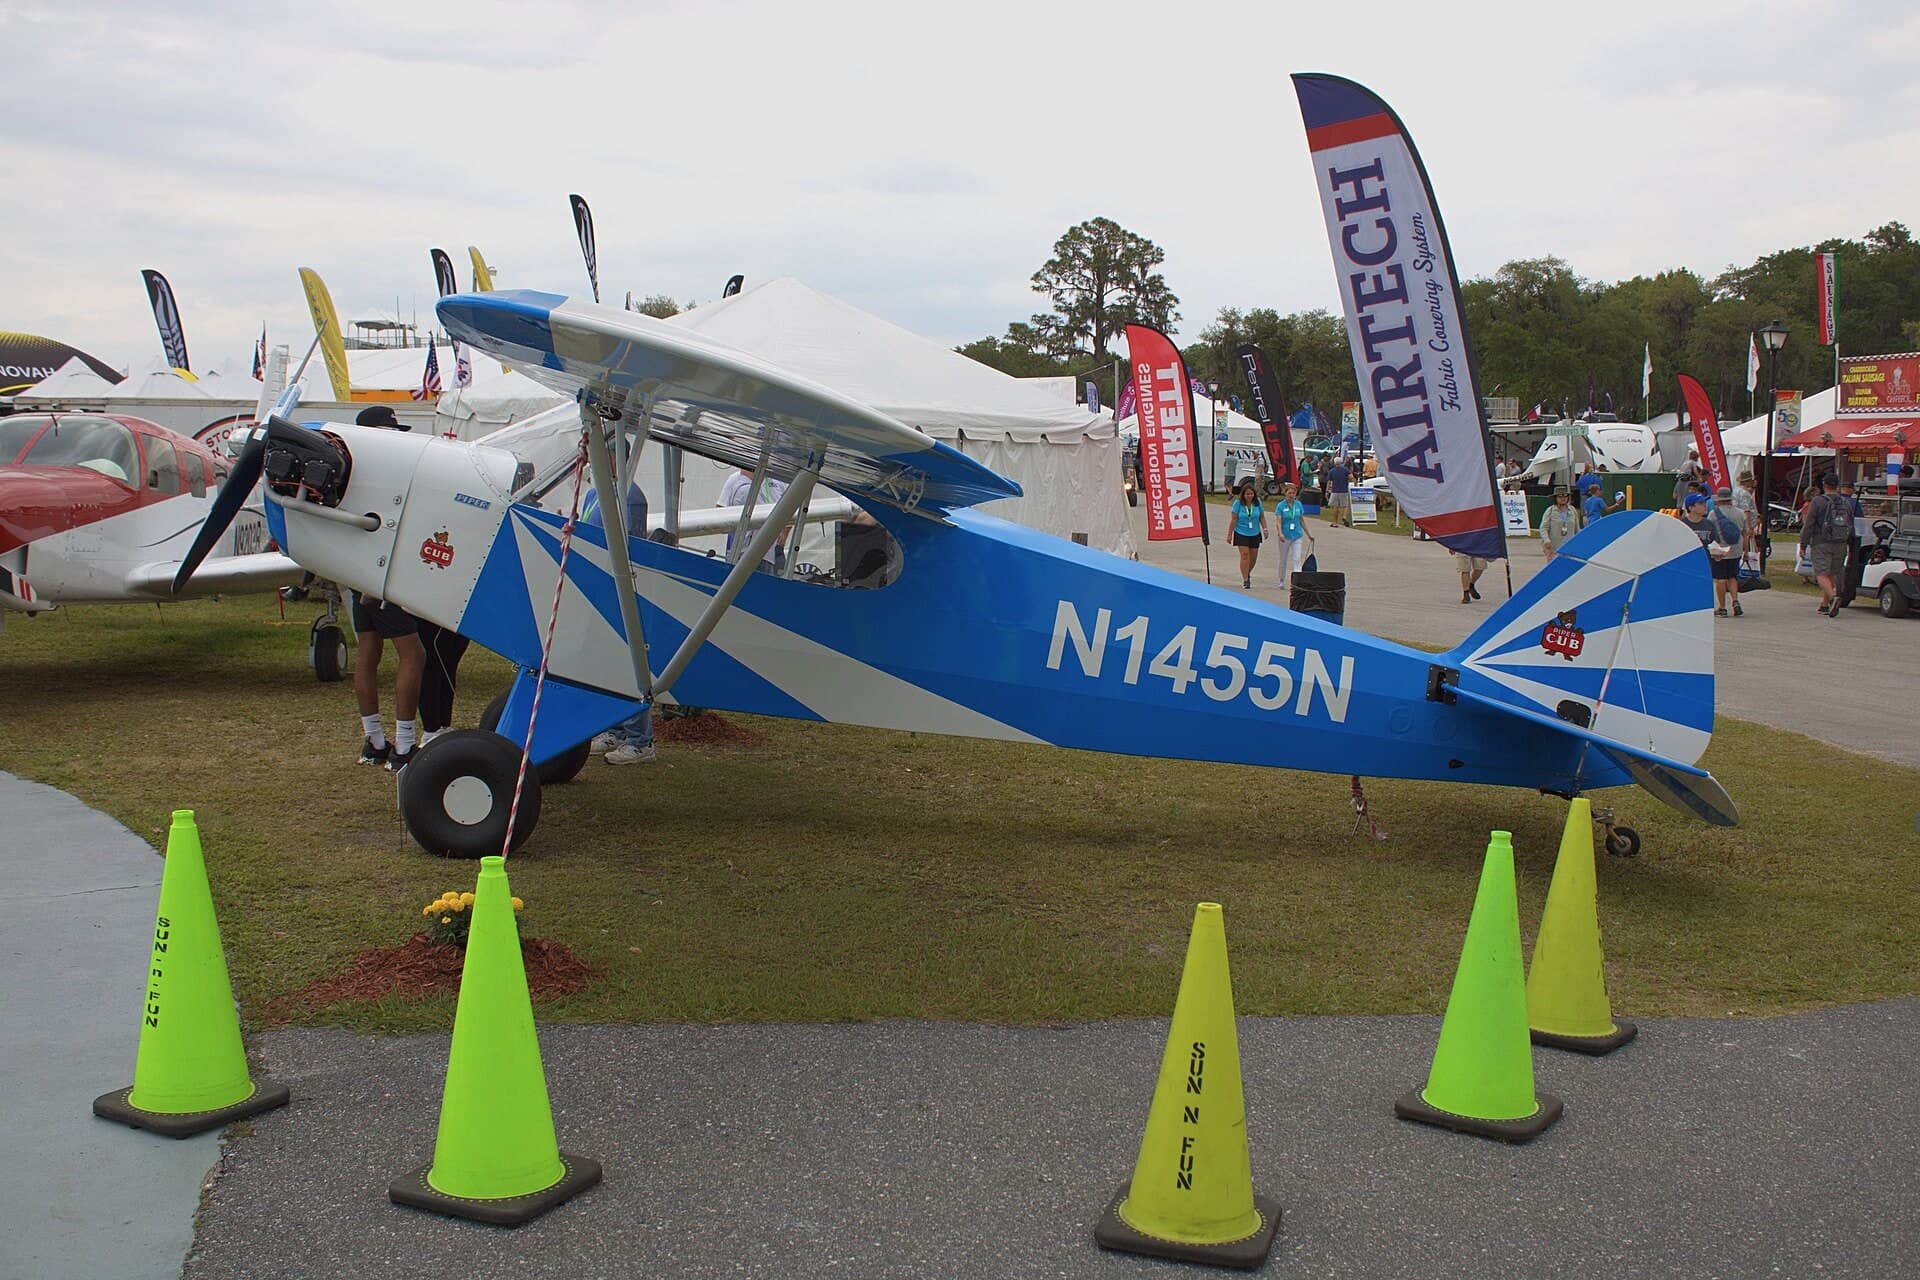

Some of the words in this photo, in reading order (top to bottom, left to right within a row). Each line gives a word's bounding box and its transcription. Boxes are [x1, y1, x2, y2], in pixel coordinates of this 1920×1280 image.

[1413, 212, 1436, 273] System
[1328, 156, 1446, 484] AIRTECH
[1428, 278, 1449, 353] Covering
[1440, 358, 1462, 413] Fabric
[1265, 424, 1287, 480] USA
[1699, 418, 1723, 486] HONDA
[456, 494, 488, 509] PIPER
[423, 546, 450, 561] CUB
[1545, 633, 1580, 650] CUB
[1553, 627, 1577, 639] PIPER
[1046, 599, 1354, 723] N1455N
[1187, 1041, 1206, 1095] SUN
[1183, 1106, 1200, 1124] N
[1176, 1137, 1195, 1190] FUN
